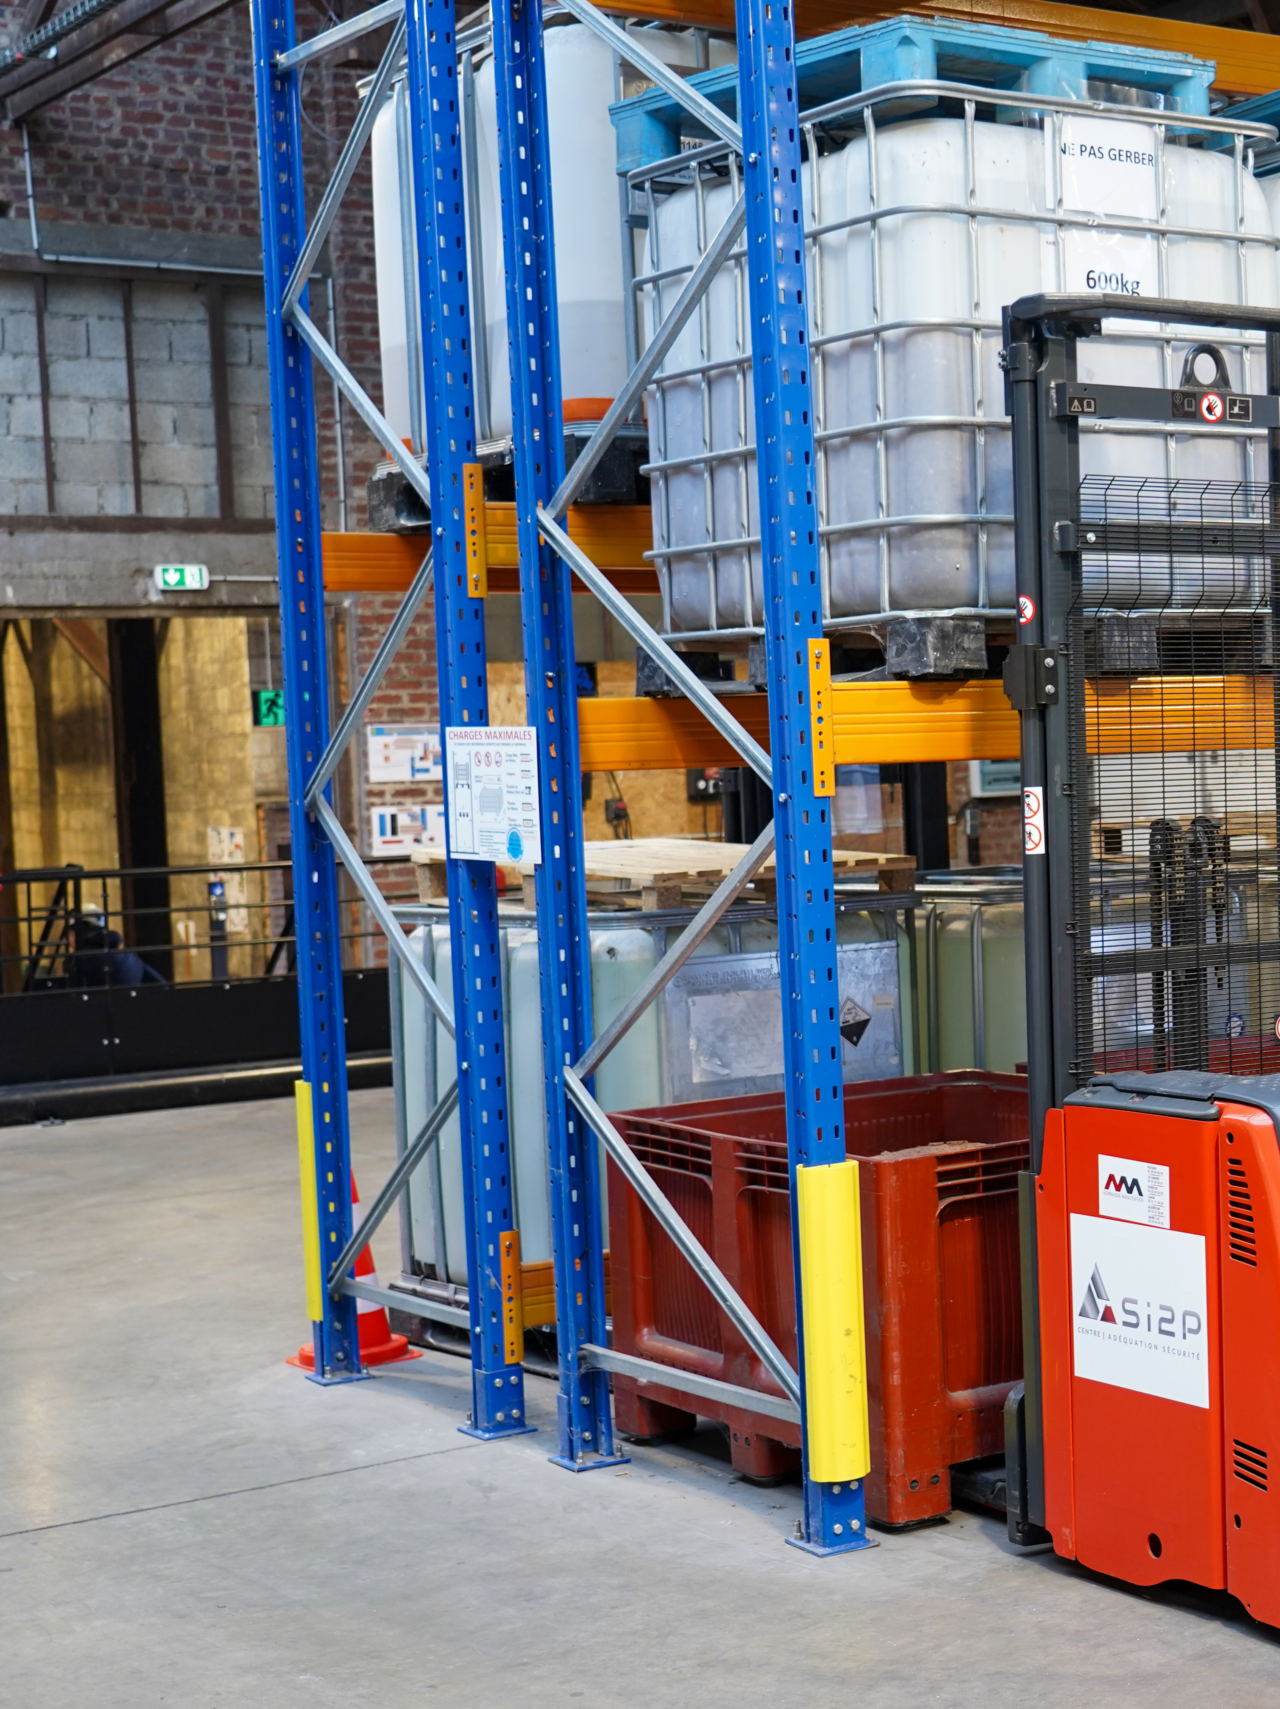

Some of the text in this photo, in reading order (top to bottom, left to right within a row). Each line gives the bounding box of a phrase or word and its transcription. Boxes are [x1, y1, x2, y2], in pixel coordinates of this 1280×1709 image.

[1080, 144, 1104, 160] PAS
[1108, 148, 1154, 167] GERBER
[1085, 270, 1140, 297] 600kg
[448, 730, 533, 741] CHARGES MAXIMALES
[1077, 1326, 1201, 1361] CENTRE ADÉQUATION SÉCURITÉ
